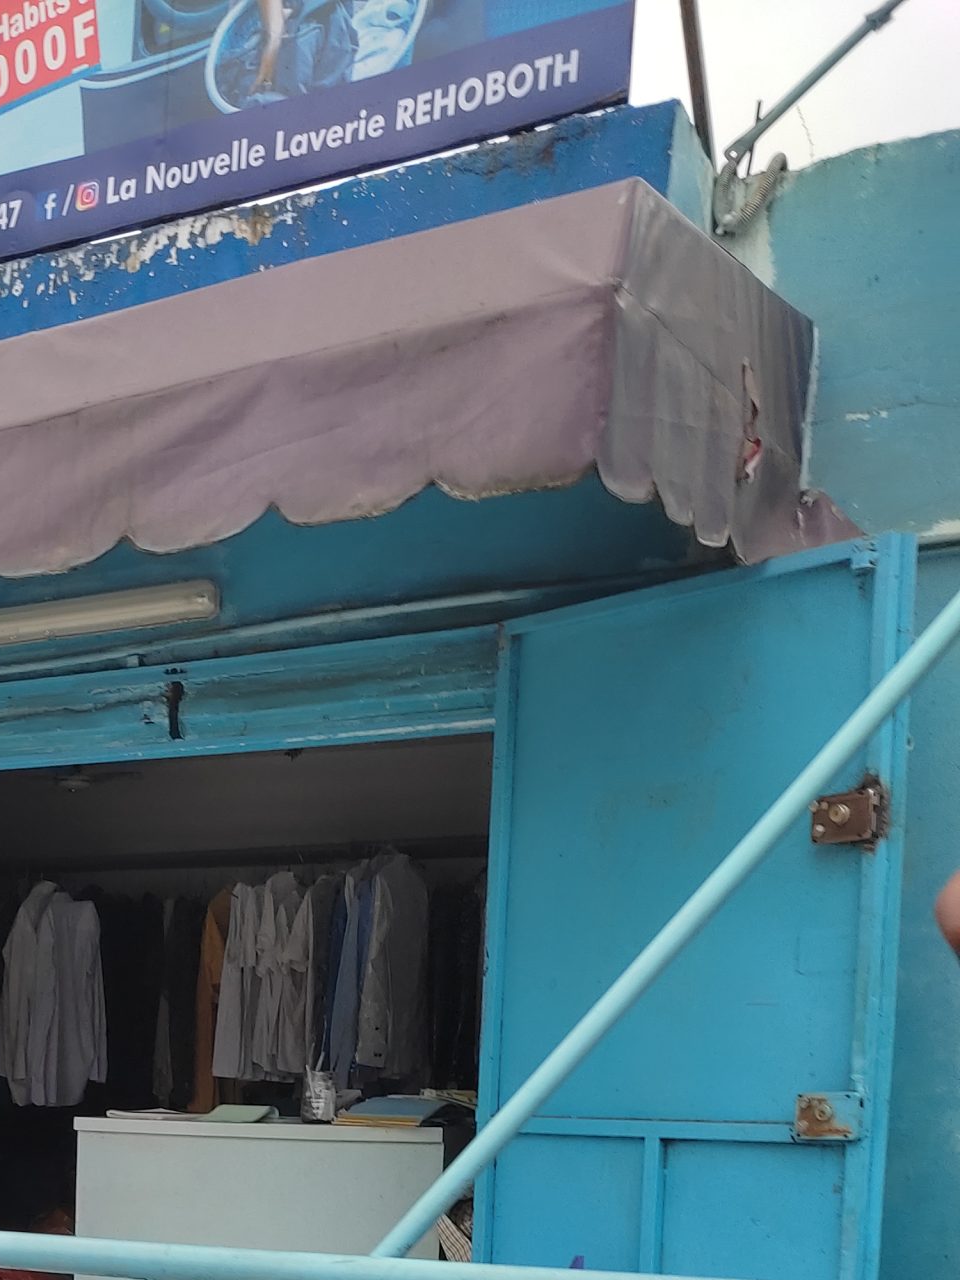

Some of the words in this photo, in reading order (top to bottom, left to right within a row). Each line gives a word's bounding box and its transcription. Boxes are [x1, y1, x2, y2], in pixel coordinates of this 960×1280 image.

[106, 176, 137, 204] La
[144, 138, 266, 195] Nouvelle
[275, 109, 385, 161] Laverie
[395, 49, 579, 131] REHOBOTH
